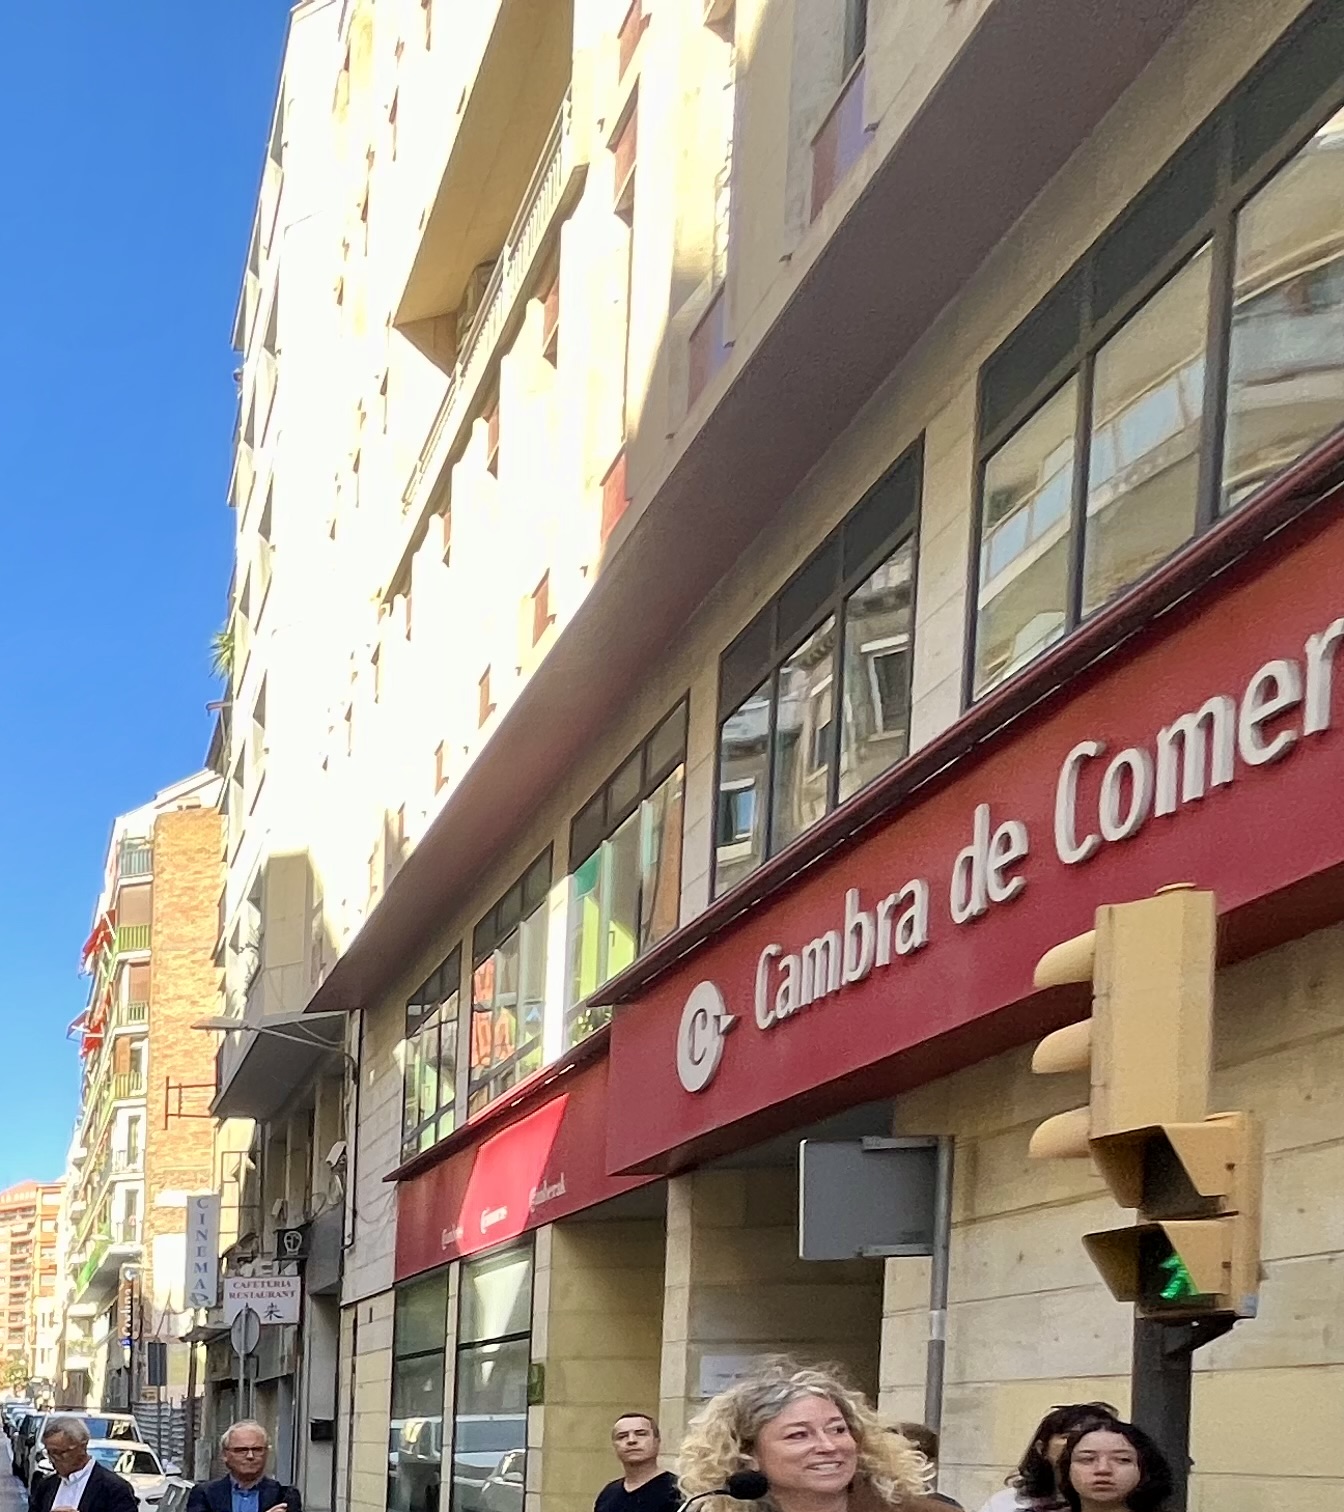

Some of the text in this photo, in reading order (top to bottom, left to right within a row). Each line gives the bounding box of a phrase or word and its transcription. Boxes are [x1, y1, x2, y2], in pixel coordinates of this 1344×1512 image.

[755, 878, 930, 1031] Cambra
[950, 803, 1029, 924] de
[228, 1290, 296, 1299] RESTAURANT
